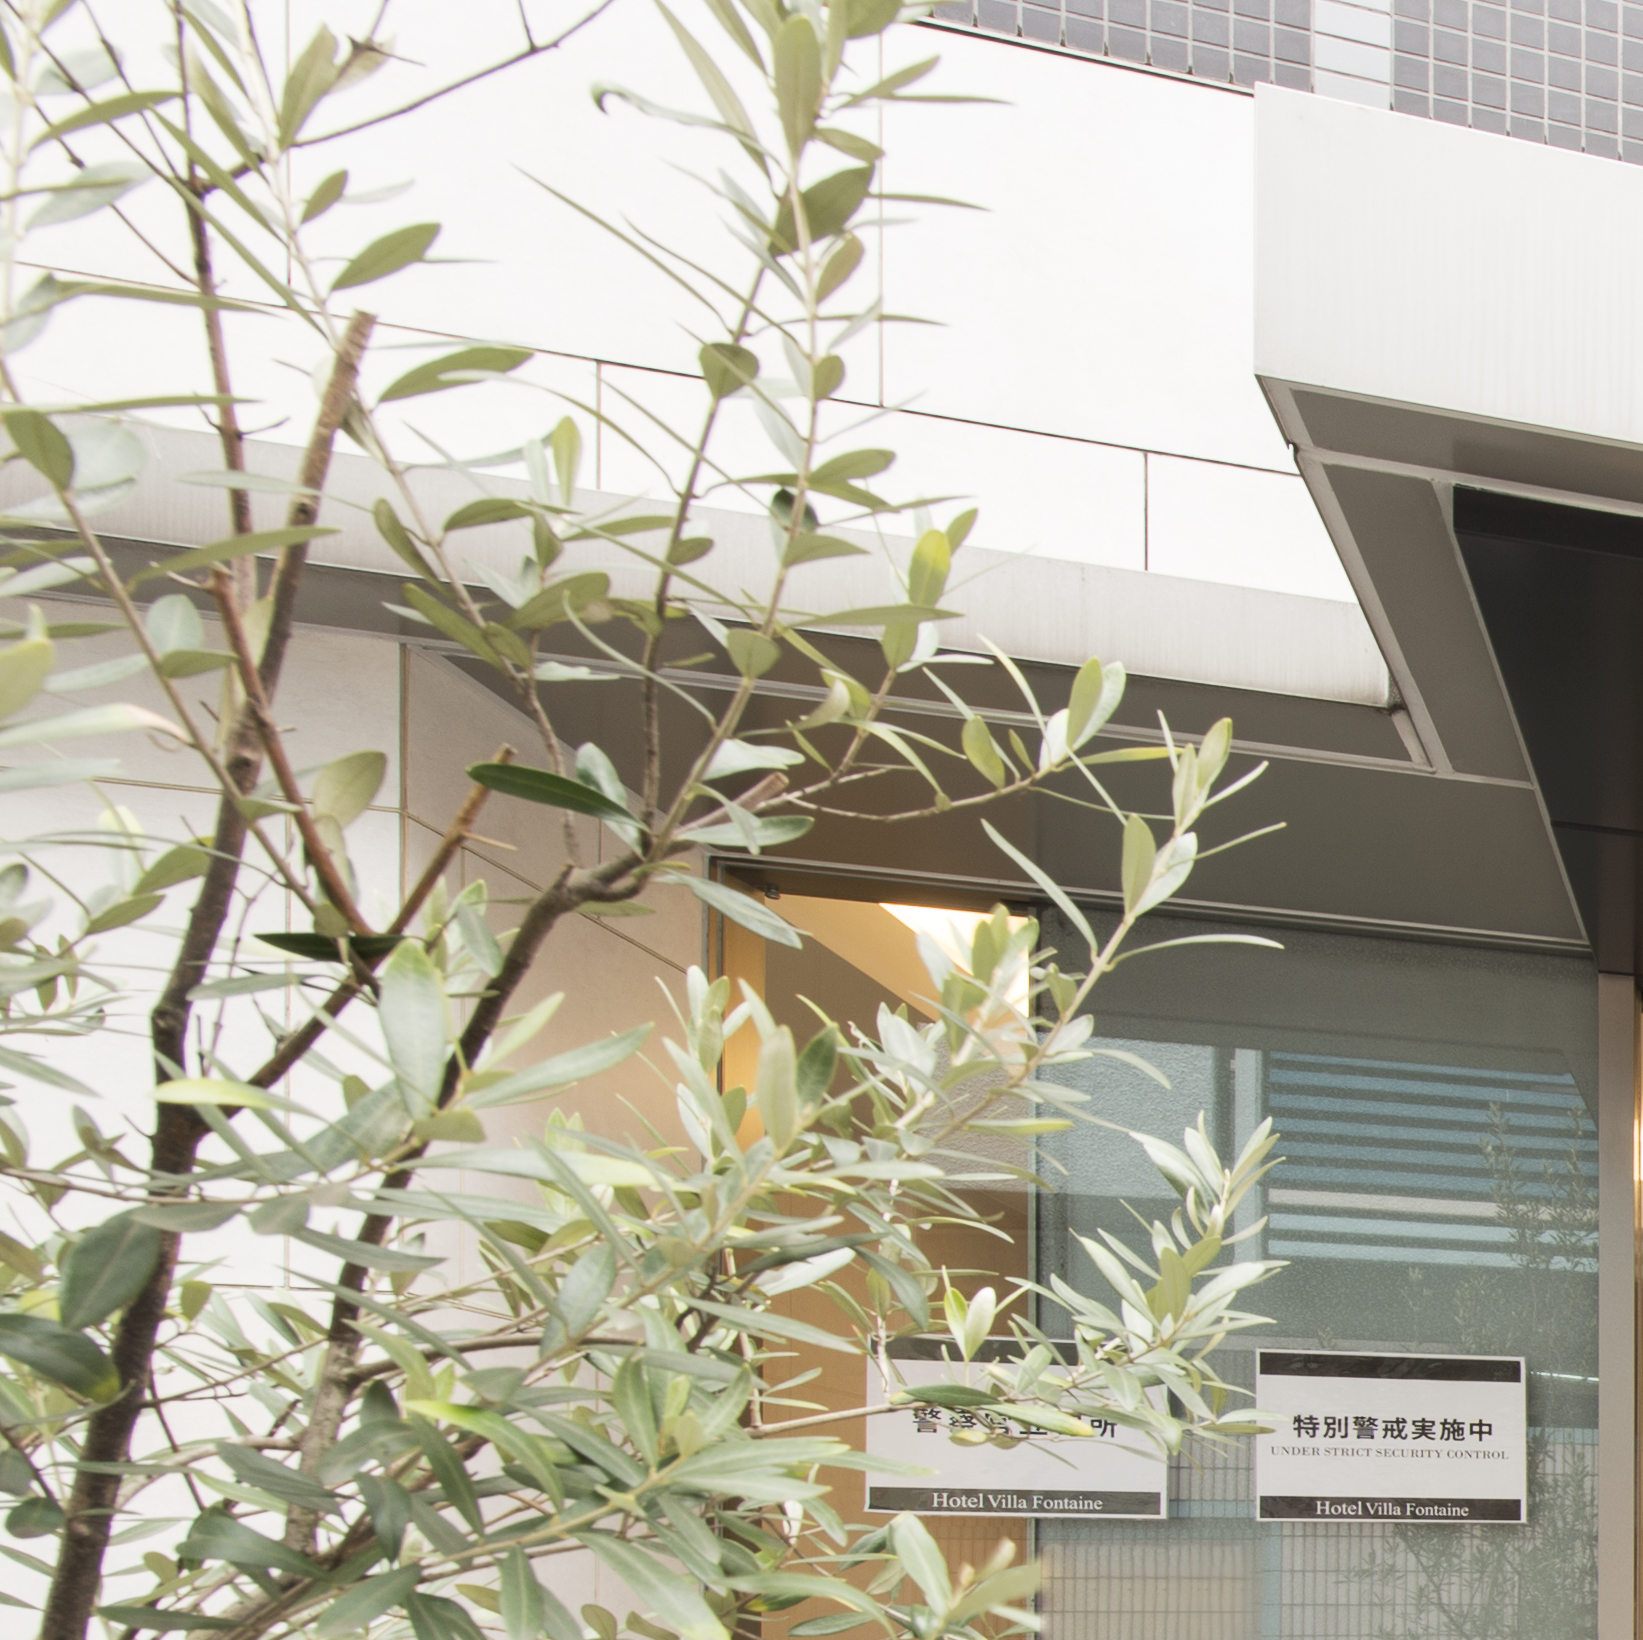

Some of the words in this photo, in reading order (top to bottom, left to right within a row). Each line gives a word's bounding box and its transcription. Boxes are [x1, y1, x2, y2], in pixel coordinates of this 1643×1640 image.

[1292, 1414, 1493, 1442] 特別警戒実施中
[1271, 1446, 1320, 1457] UNDER
[1324, 1447, 1373, 1458] STRICT
[1375, 1448, 1443, 1459] SECURITY
[1446, 1449, 1509, 1460] CONTROL
[932, 1492, 984, 1508] Hotel
[987, 1494, 1027, 1509] Villa
[1032, 1496, 1103, 1511] Fontaine
[1315, 1500, 1362, 1516] Hotel
[1366, 1502, 1401, 1516] Villa
[1405, 1503, 1469, 1517] Fontaine
